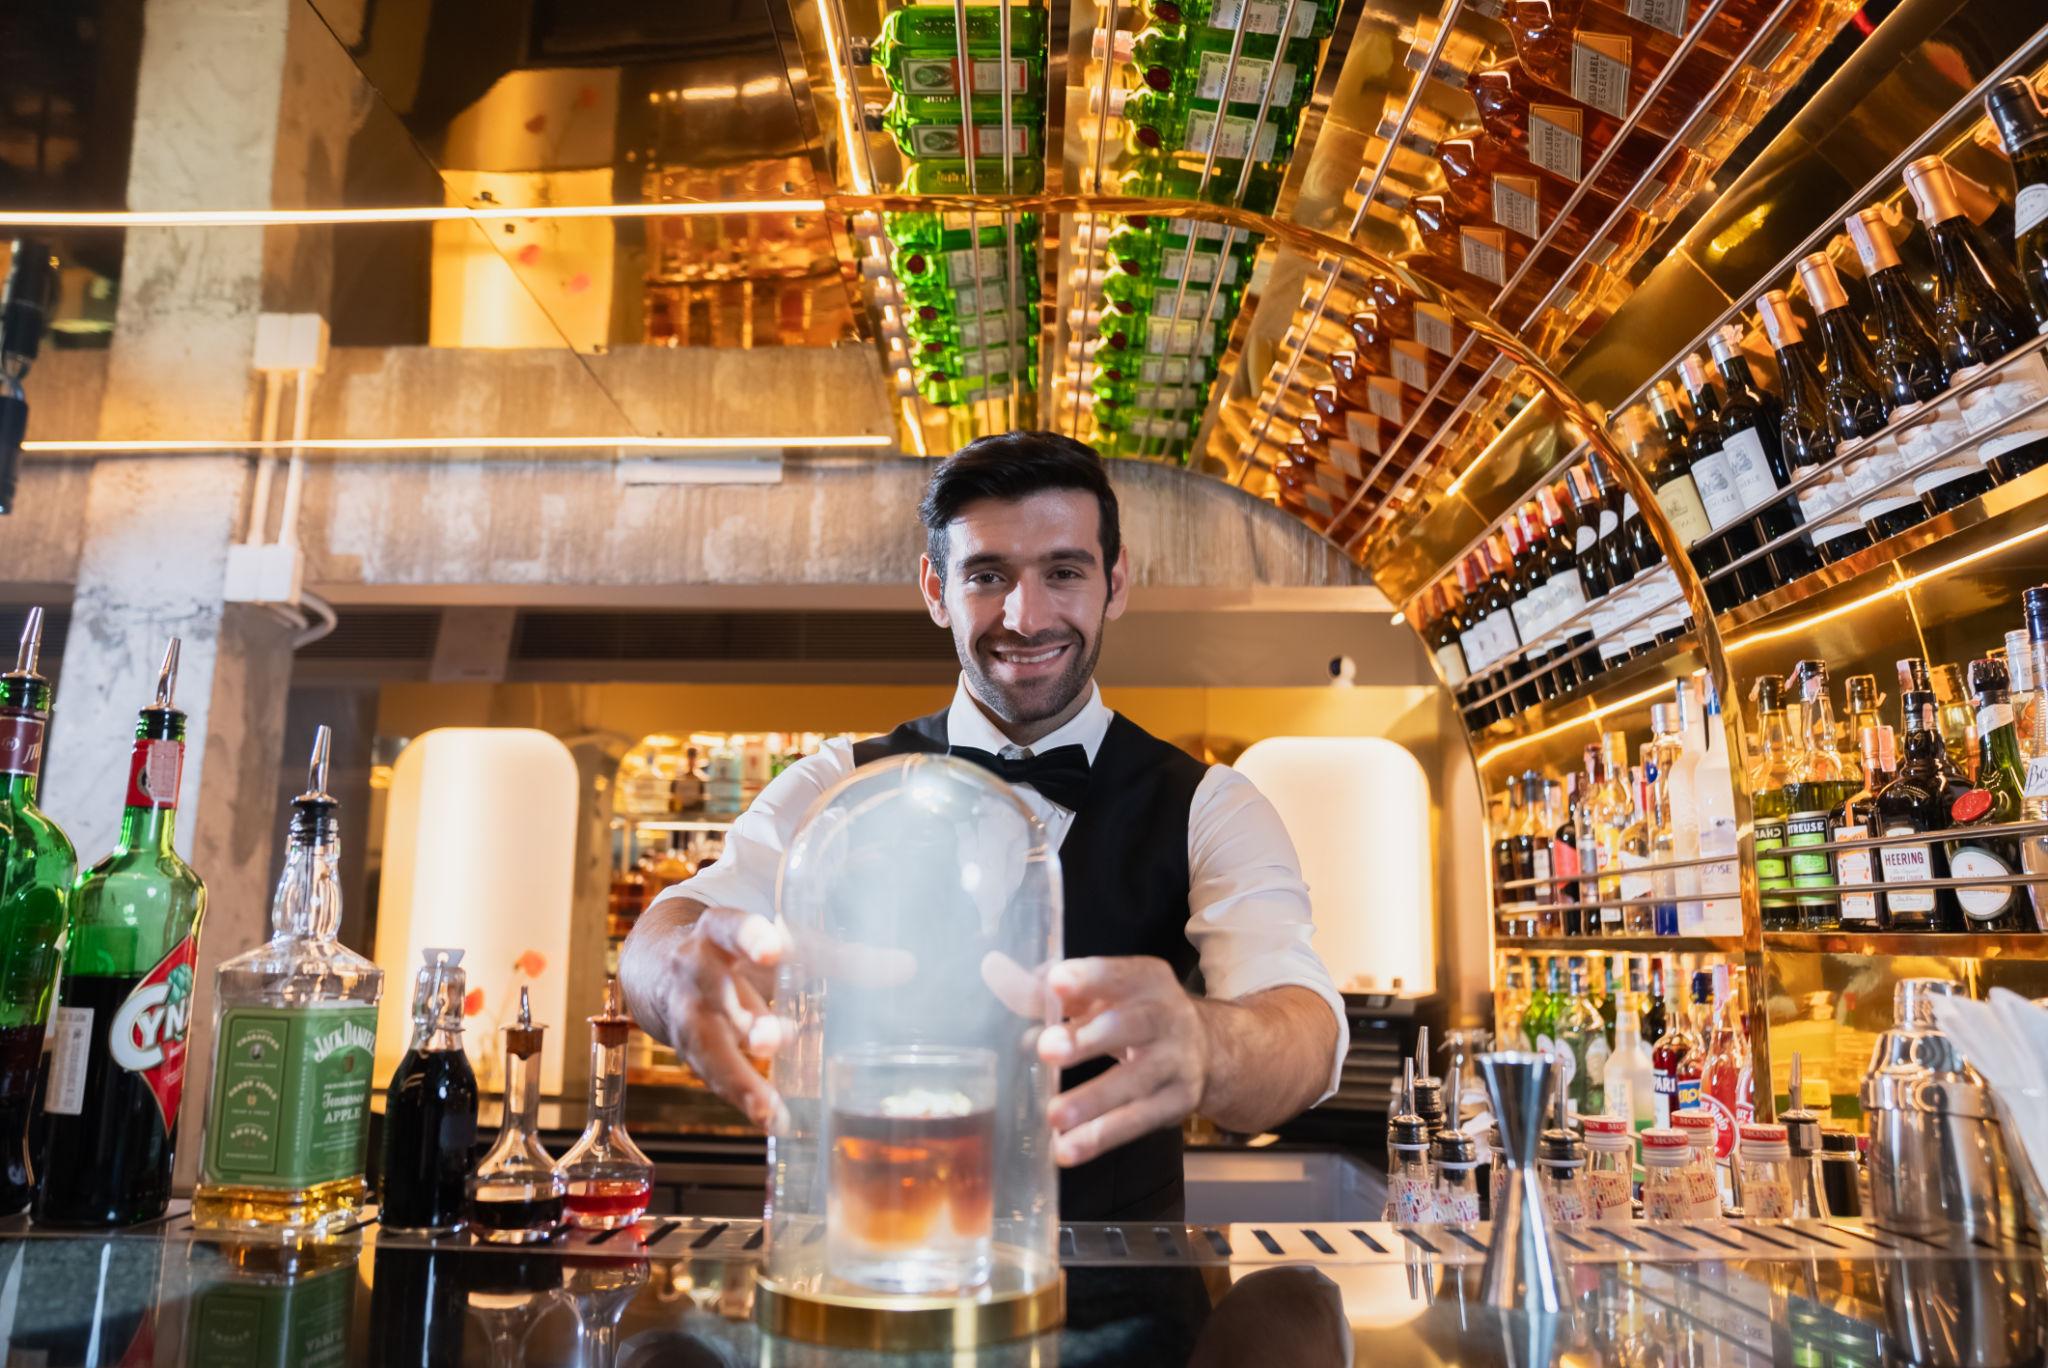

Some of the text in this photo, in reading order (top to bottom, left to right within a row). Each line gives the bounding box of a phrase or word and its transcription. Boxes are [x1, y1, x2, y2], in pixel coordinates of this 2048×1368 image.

[1589, 53, 1600, 84] LABEL
[1598, 60, 1609, 106] RESERVE
[1884, 852, 1924, 867] HEERING
[323, 1107, 362, 1125] APPLE
